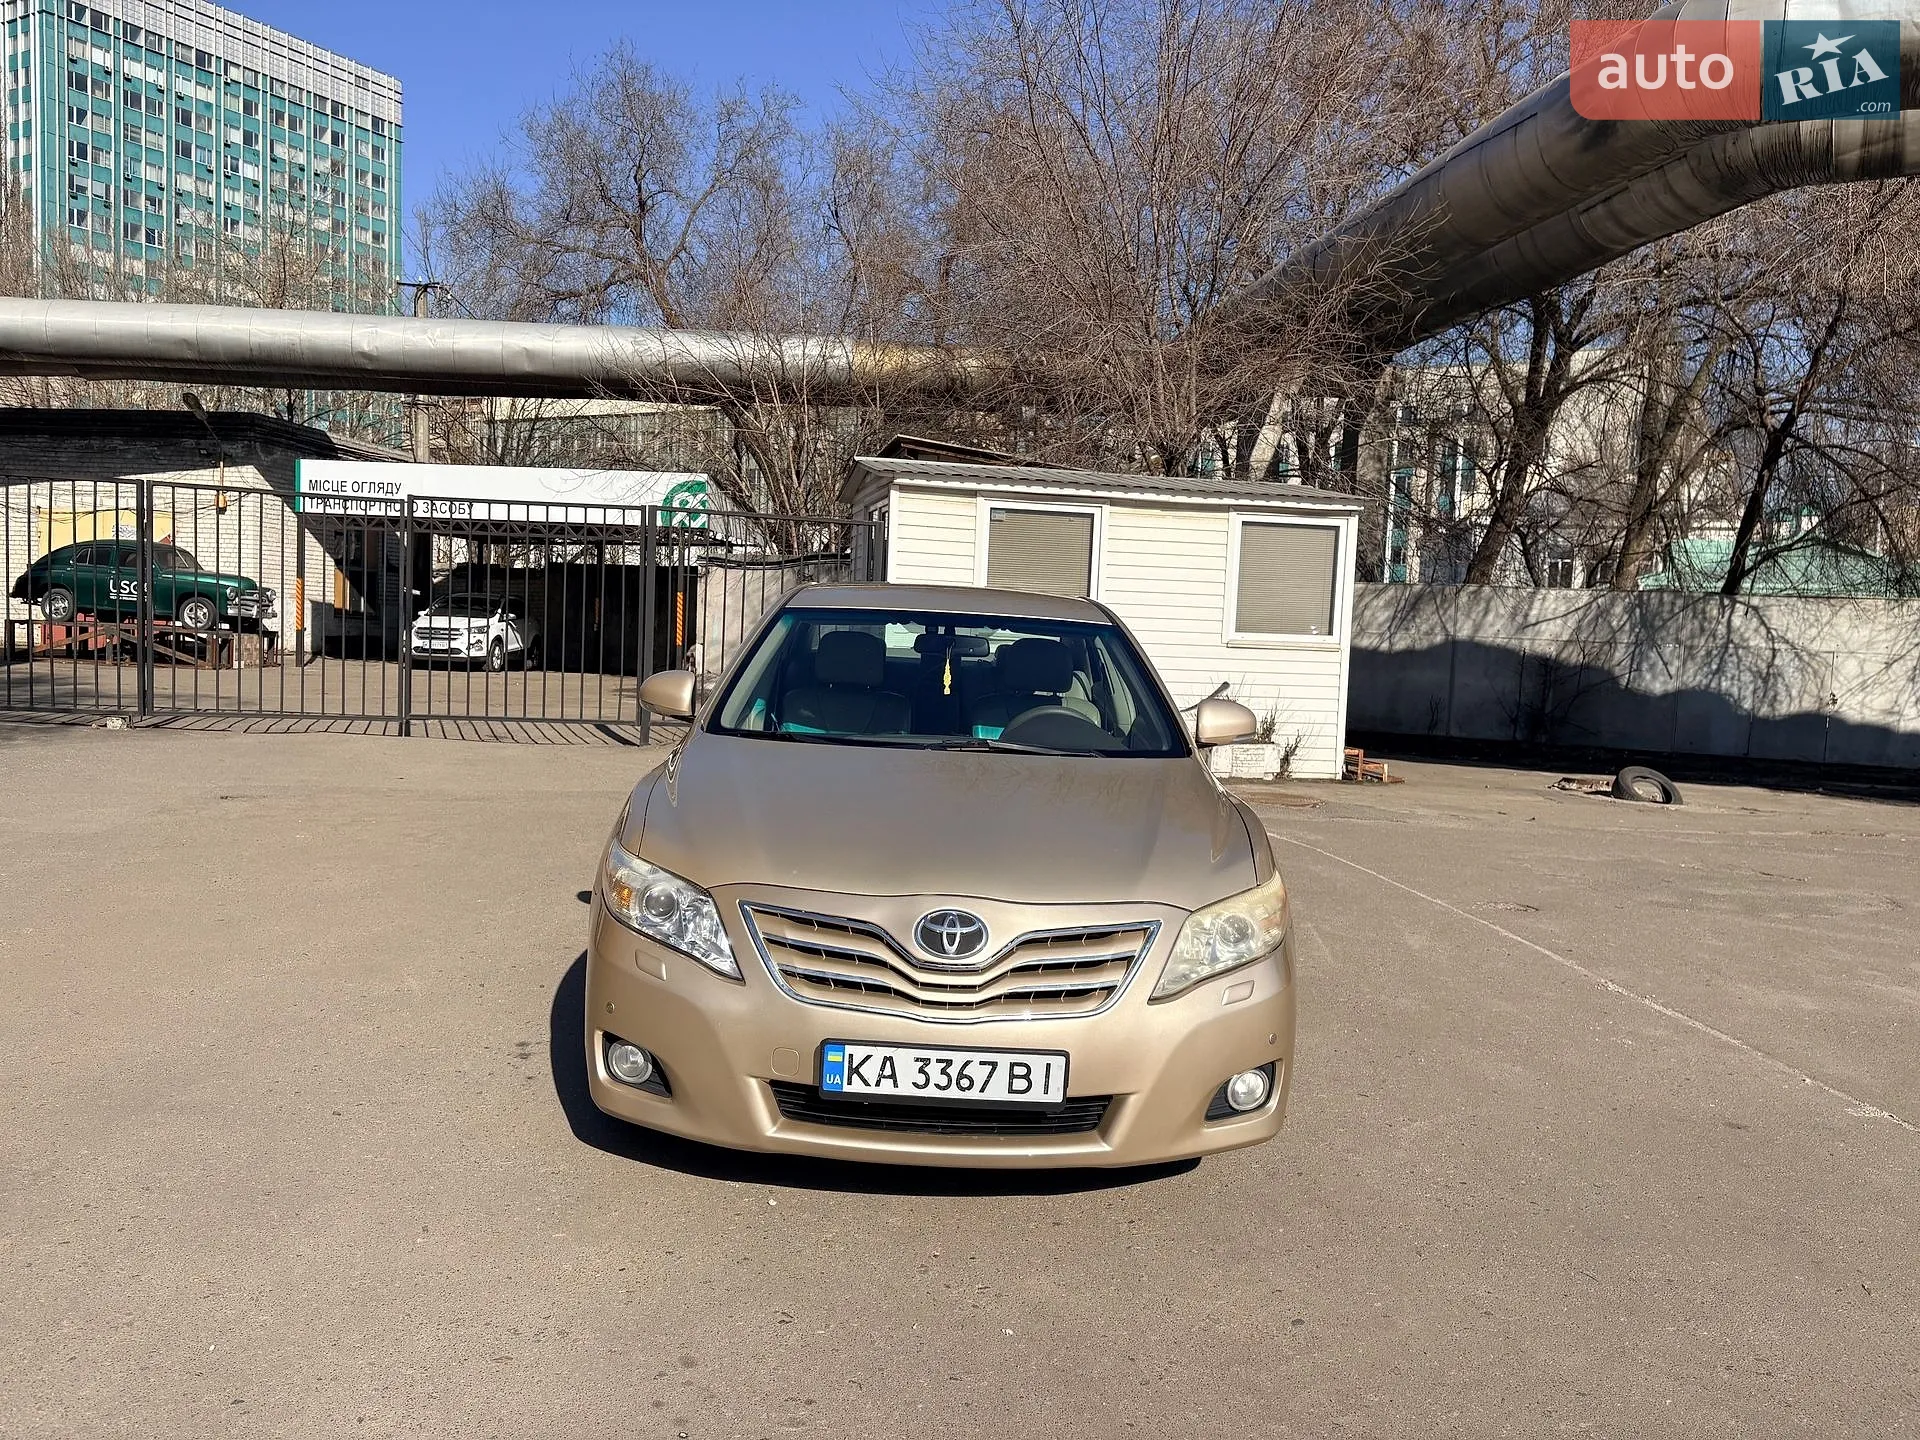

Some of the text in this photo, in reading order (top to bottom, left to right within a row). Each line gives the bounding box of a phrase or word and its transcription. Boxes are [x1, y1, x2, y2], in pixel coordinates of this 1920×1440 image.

[308, 479, 402, 497] МІСЦЕ ОГЛЯДУ
[309, 497, 475, 516] ТРАНСПОРТНОО ЗАСОБУ
[826, 1073, 842, 1085] UA
[846, 1053, 1052, 1095] KA 3367 BI
